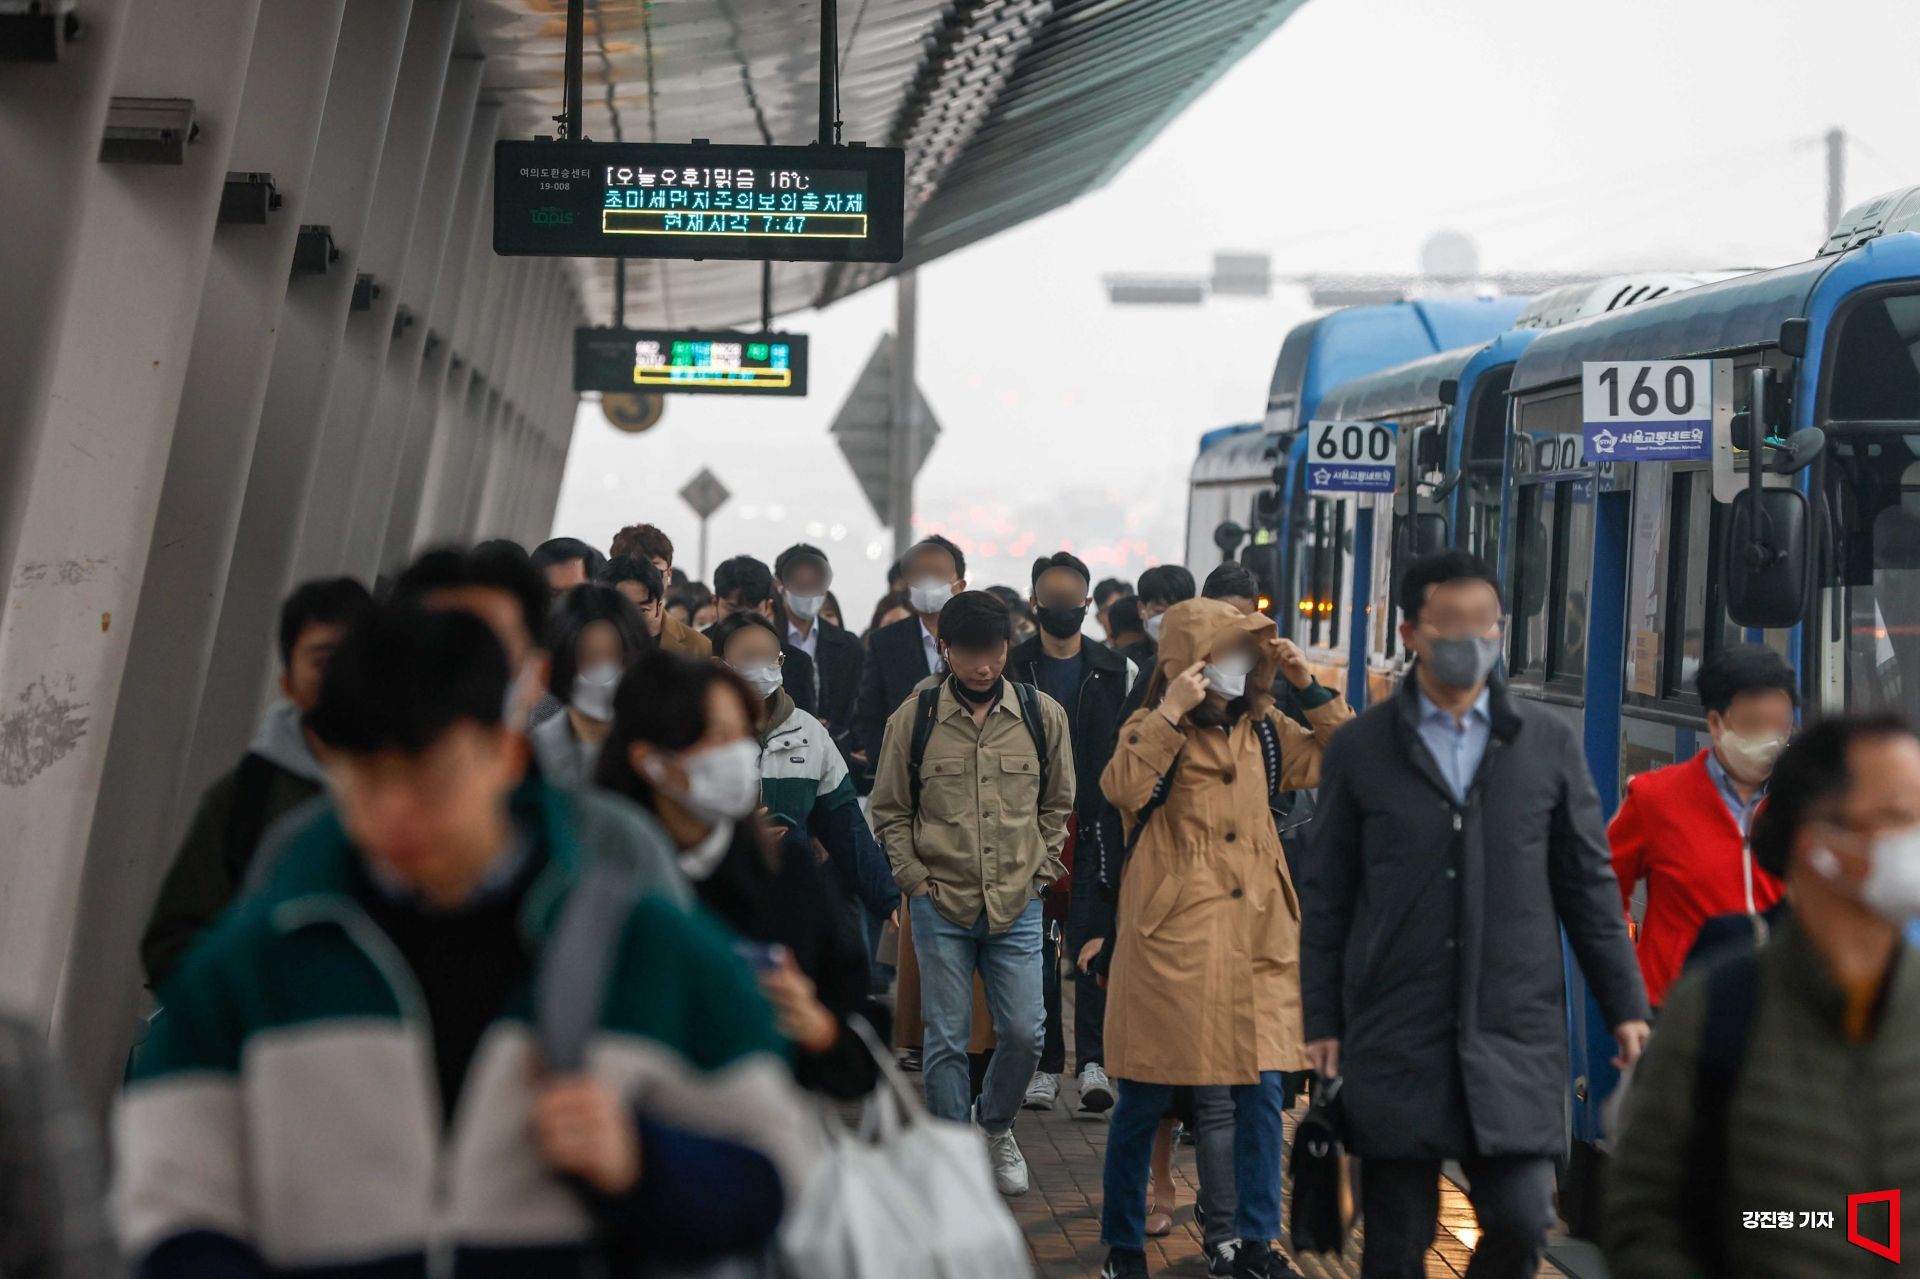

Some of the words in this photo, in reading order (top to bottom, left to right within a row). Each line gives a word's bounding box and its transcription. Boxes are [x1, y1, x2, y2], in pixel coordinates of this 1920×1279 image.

[520, 167, 590, 179] 여의도환승센터
[540, 182, 570, 191] 19-008
[763, 215, 806, 233] 7:47
[1599, 365, 1695, 417] 160
[1317, 425, 1390, 461] 600
